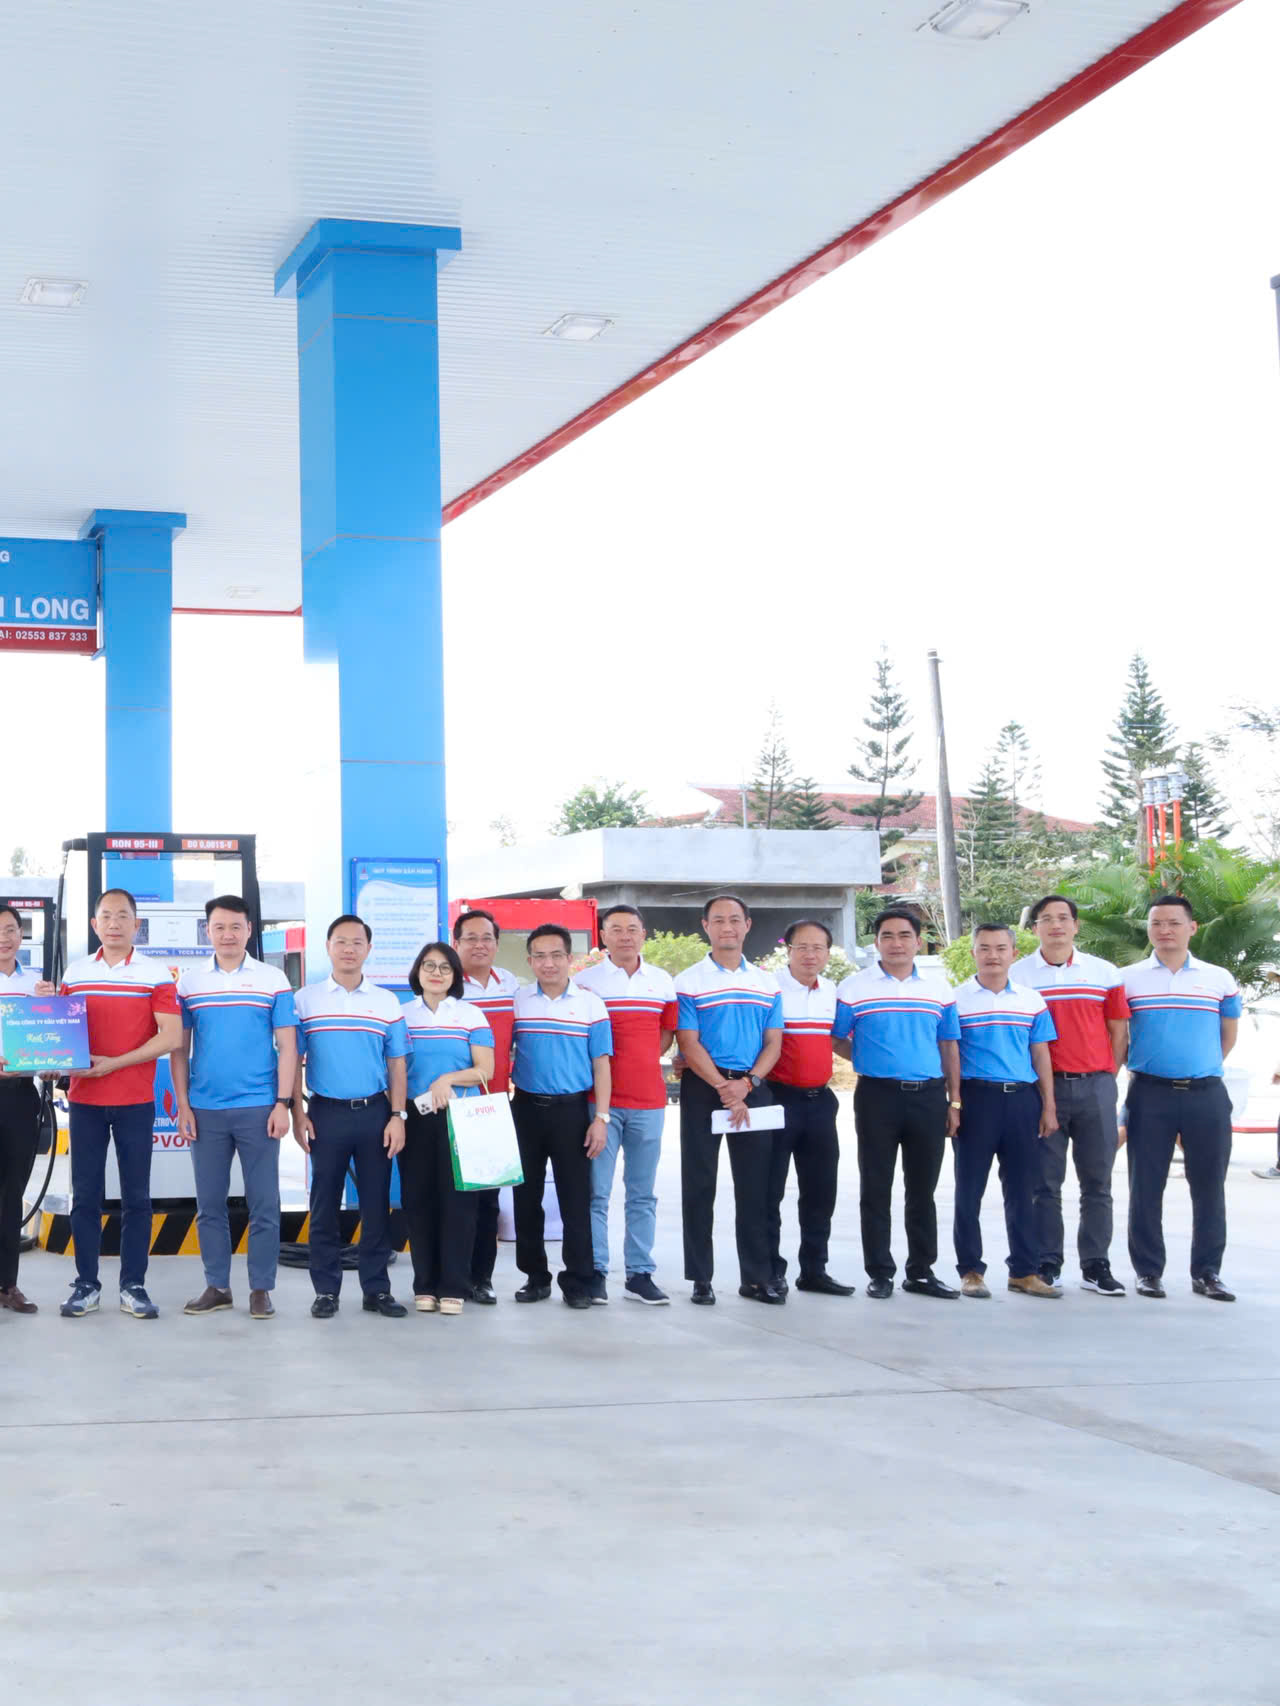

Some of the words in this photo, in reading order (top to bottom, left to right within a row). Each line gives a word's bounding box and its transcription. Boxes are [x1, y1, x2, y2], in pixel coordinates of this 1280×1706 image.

[15, 596, 89, 621] LONG
[15, 630, 46, 641] 02553
[48, 631, 67, 641] 837
[69, 631, 88, 642] 333
[111, 839, 132, 848] RON
[133, 840, 158, 849] 95-III
